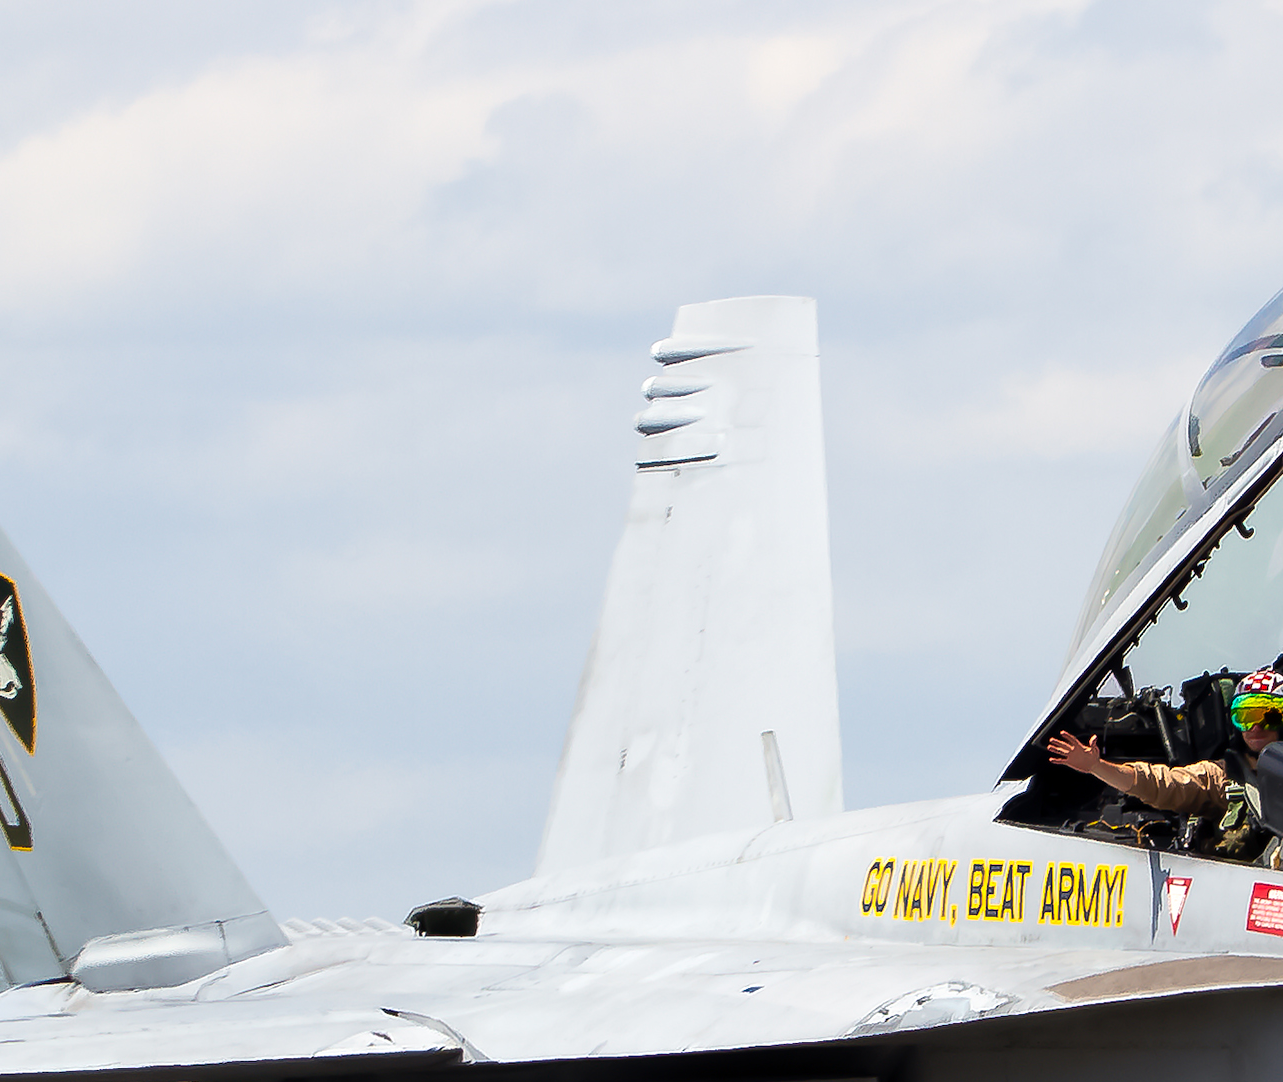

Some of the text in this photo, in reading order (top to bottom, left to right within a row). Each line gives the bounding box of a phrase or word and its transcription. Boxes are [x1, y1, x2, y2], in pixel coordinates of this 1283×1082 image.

[861, 857, 1129, 928] GO NAVY, BEAT ARMY!
